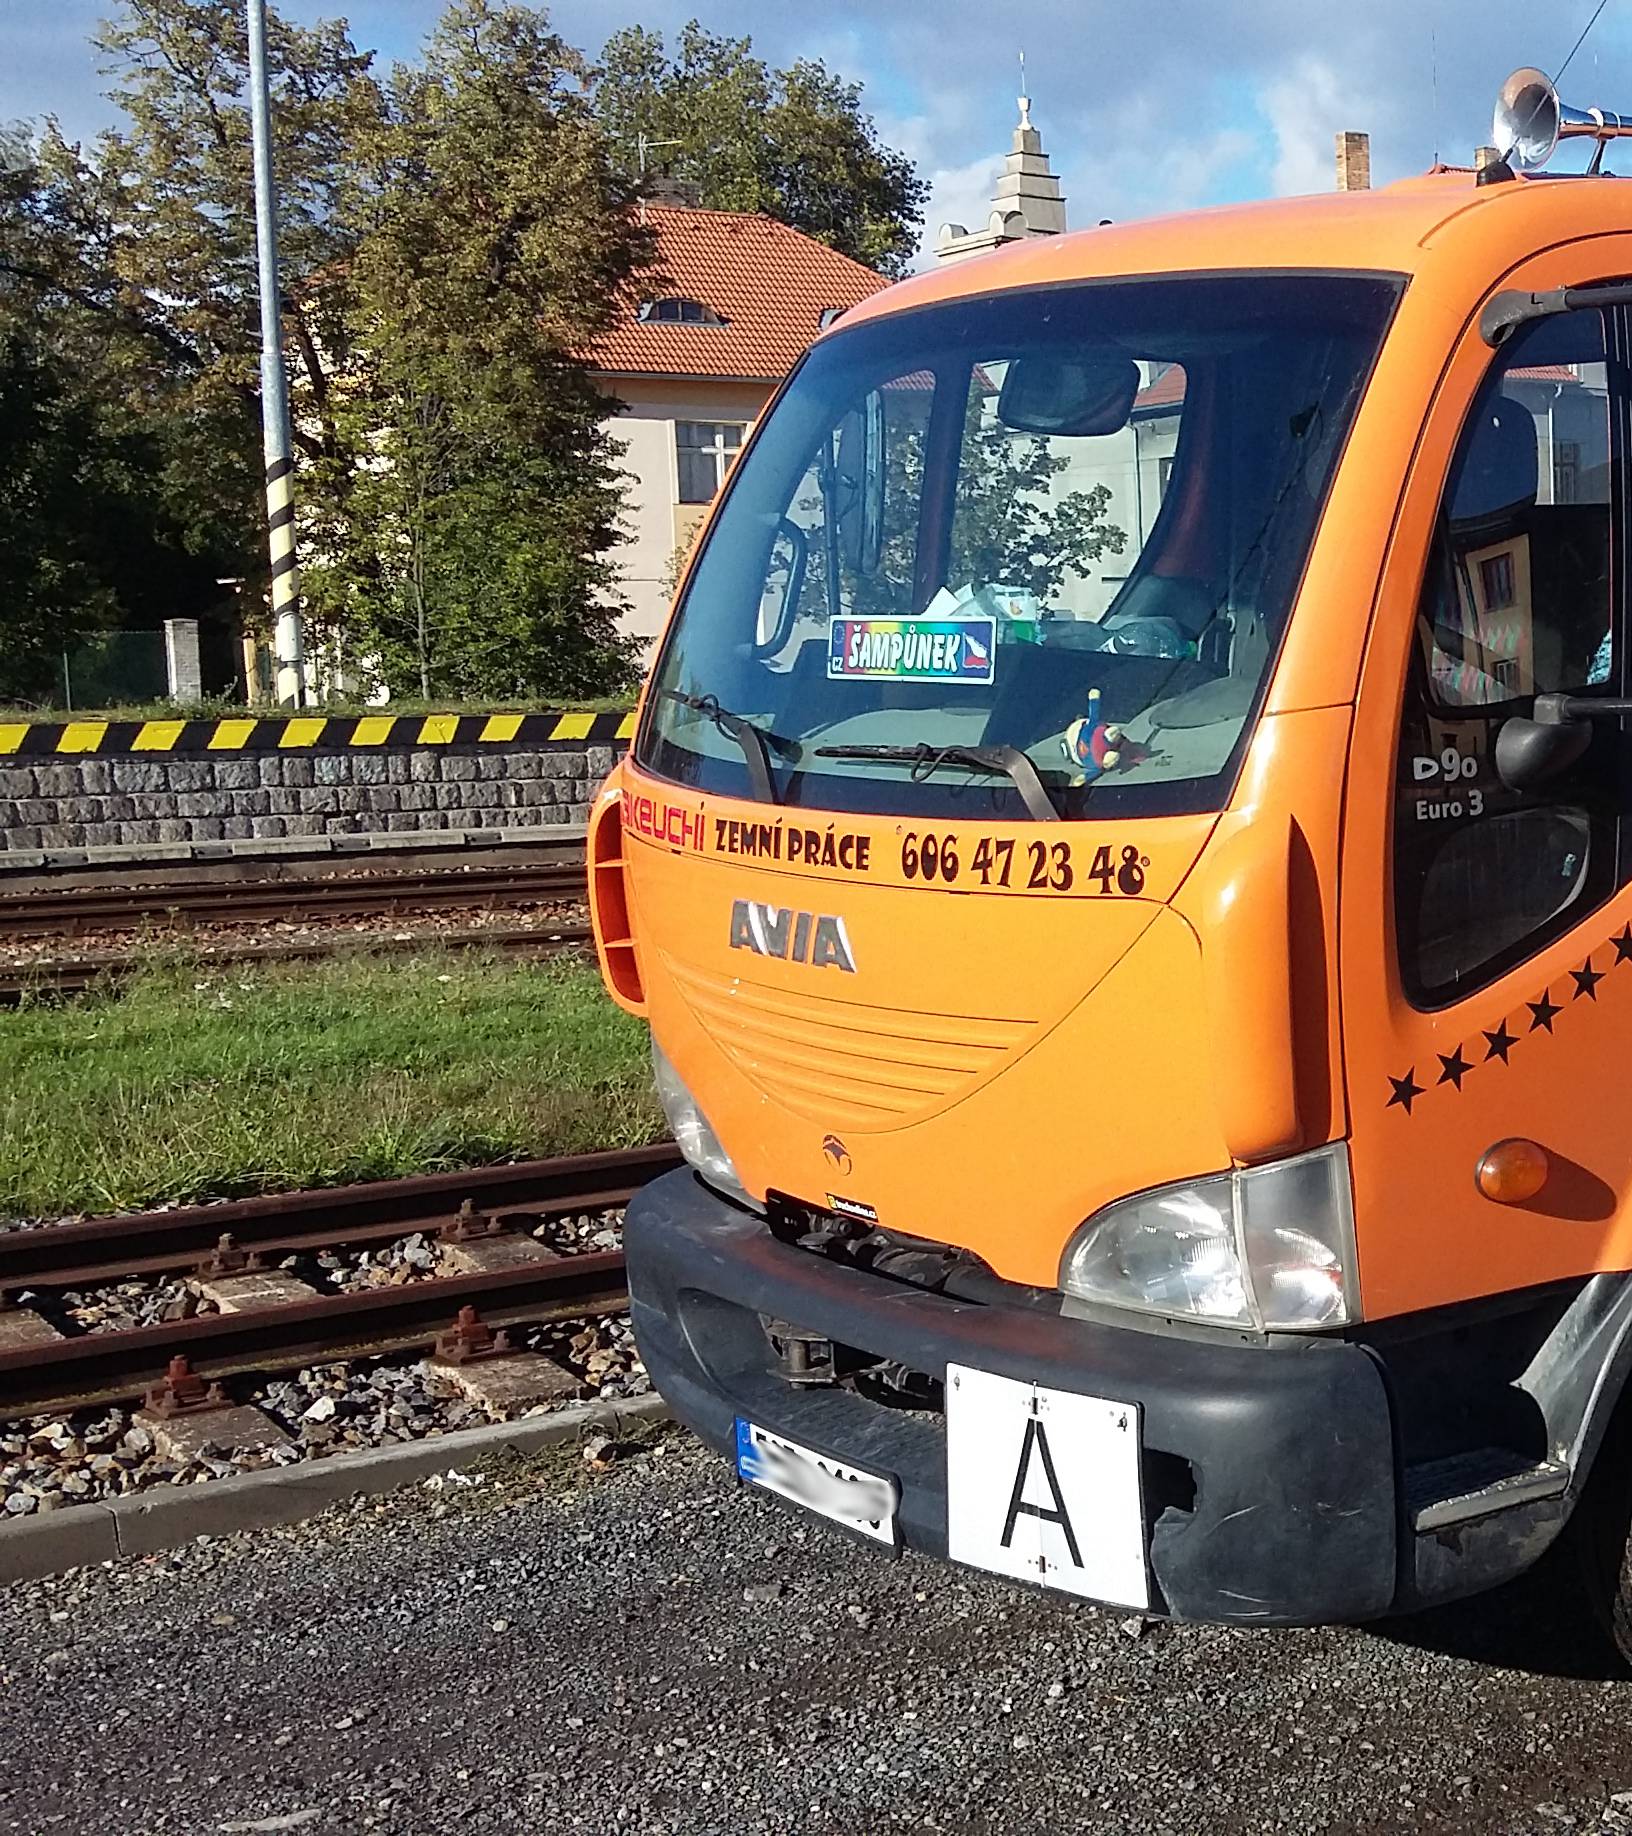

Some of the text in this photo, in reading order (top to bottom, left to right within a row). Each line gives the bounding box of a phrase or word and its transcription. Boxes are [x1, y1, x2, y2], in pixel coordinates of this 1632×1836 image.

[832, 656, 844, 672] CZ
[848, 624, 961, 674] ŠAMPŮNEK
[1416, 789, 1484, 820] Euro 3
[715, 816, 783, 860] ZEMNÍ
[787, 822, 872, 872] PRÁCE
[901, 832, 960, 883] 606
[970, 837, 1017, 888] 47
[1026, 840, 1074, 892] 23
[1088, 844, 1146, 895] 48
[729, 899, 858, 974] AVIA
[1000, 1418, 1085, 1569] A
